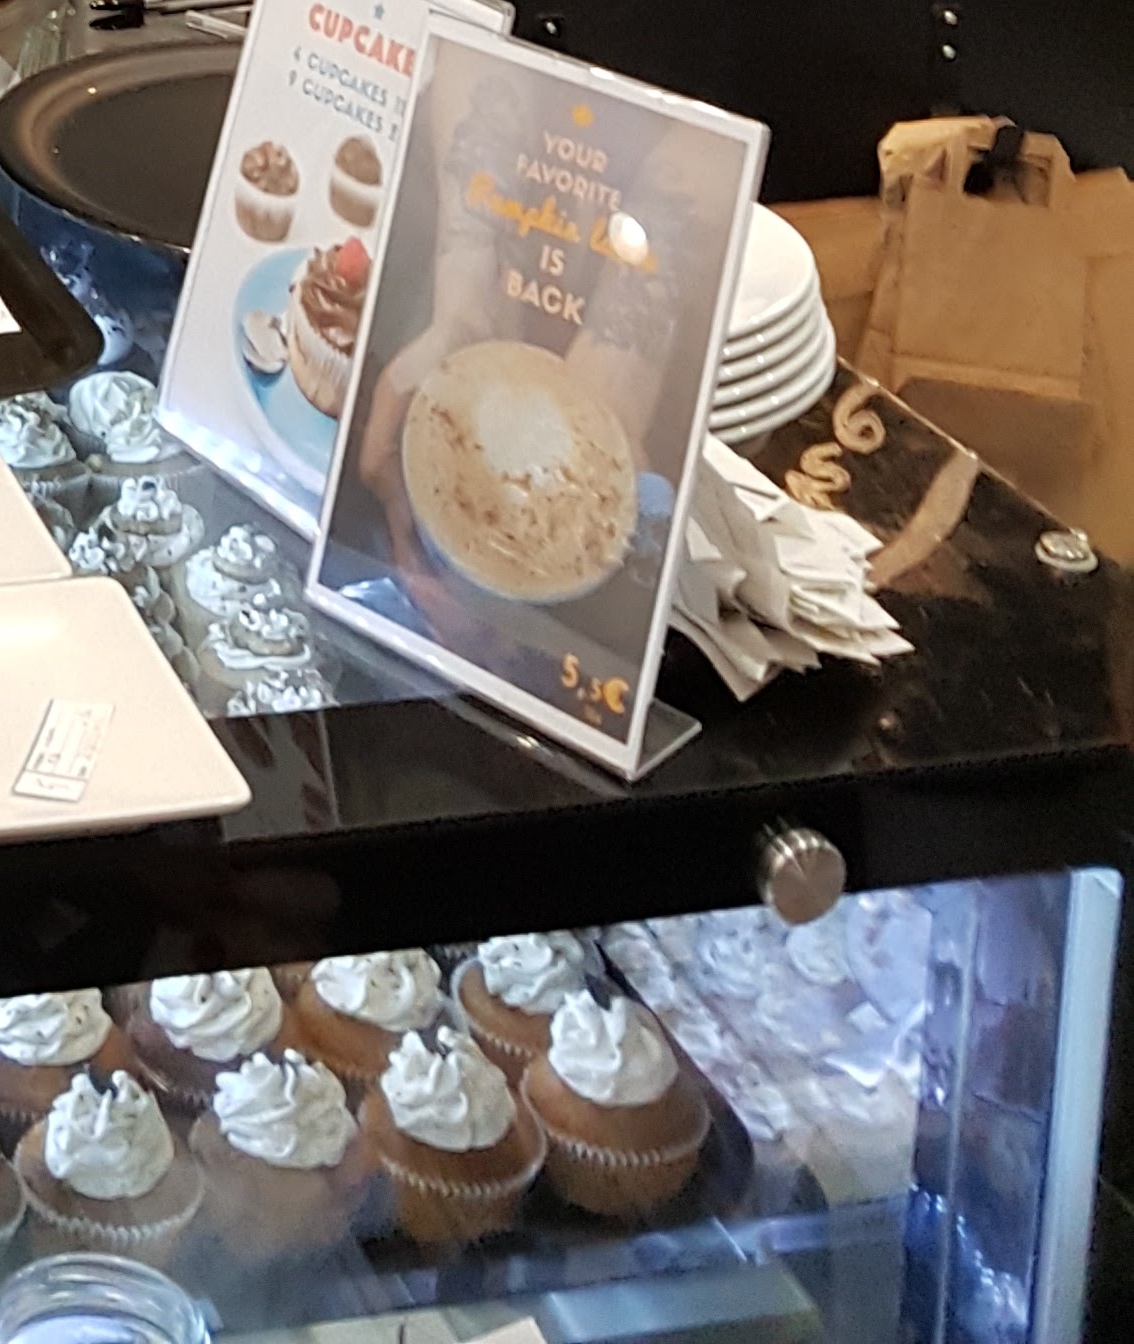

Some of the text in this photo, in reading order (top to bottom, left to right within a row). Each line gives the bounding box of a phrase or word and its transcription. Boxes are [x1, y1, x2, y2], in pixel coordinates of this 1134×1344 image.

[543, 130, 609, 174] YOUR
[516, 153, 623, 212] FAVORITE
[539, 244, 566, 278] IS
[506, 269, 587, 327] BACK
